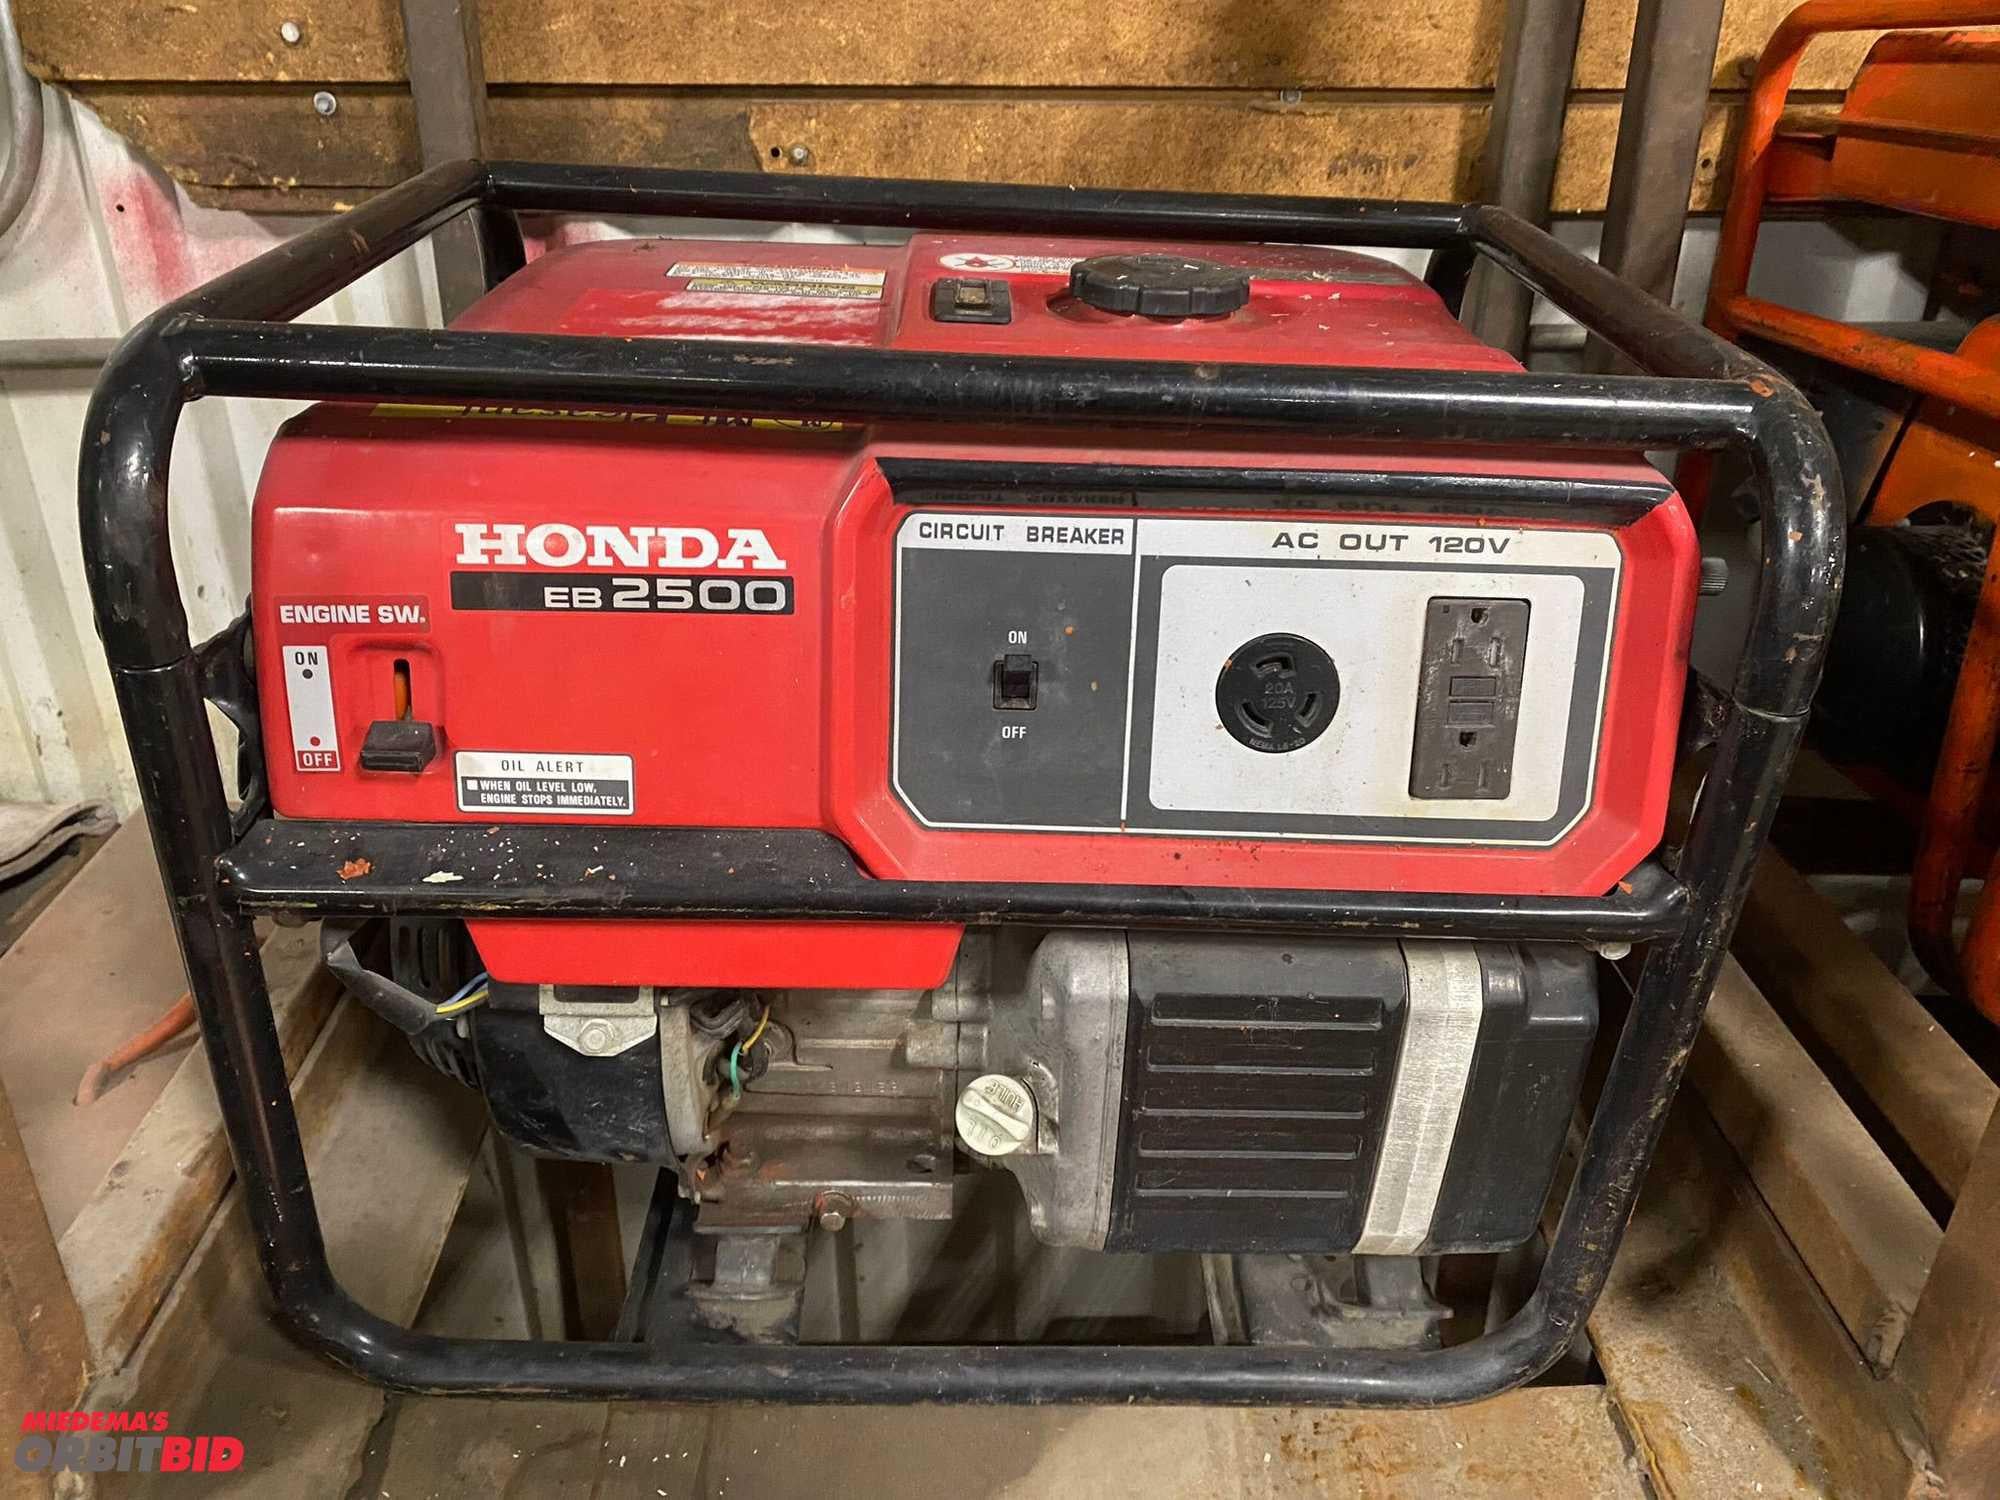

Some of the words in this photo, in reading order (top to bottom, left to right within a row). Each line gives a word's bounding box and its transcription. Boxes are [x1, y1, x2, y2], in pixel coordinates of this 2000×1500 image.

[919, 521, 1004, 541] CIRCUIT
[1026, 526, 1124, 545] BREAKER
[455, 522, 787, 570] HONDA
[1271, 532, 1319, 549] AC
[1339, 533, 1408, 552] OUT
[1428, 535, 1510, 555] 120V
[543, 586, 602, 608] EB
[611, 577, 787, 611] 2500
[279, 604, 371, 624] ENGINE
[376, 604, 426, 625] SW.
[1008, 630, 1028, 645] ON
[294, 651, 319, 666] ON
[1264, 681, 1294, 695] 20A
[1001, 725, 1027, 740] OFF
[302, 752, 334, 767] OFF
[501, 759, 525, 773] OIL
[535, 760, 584, 774] ALERT
[479, 780, 511, 792] WHEN
[515, 781, 532, 792] OIL
[536, 781, 567, 793] LEVEL
[480, 793, 517, 805] ENGINE
[521, 794, 553, 806] STOPS
[556, 795, 627, 807] IMMEDIATELY.
